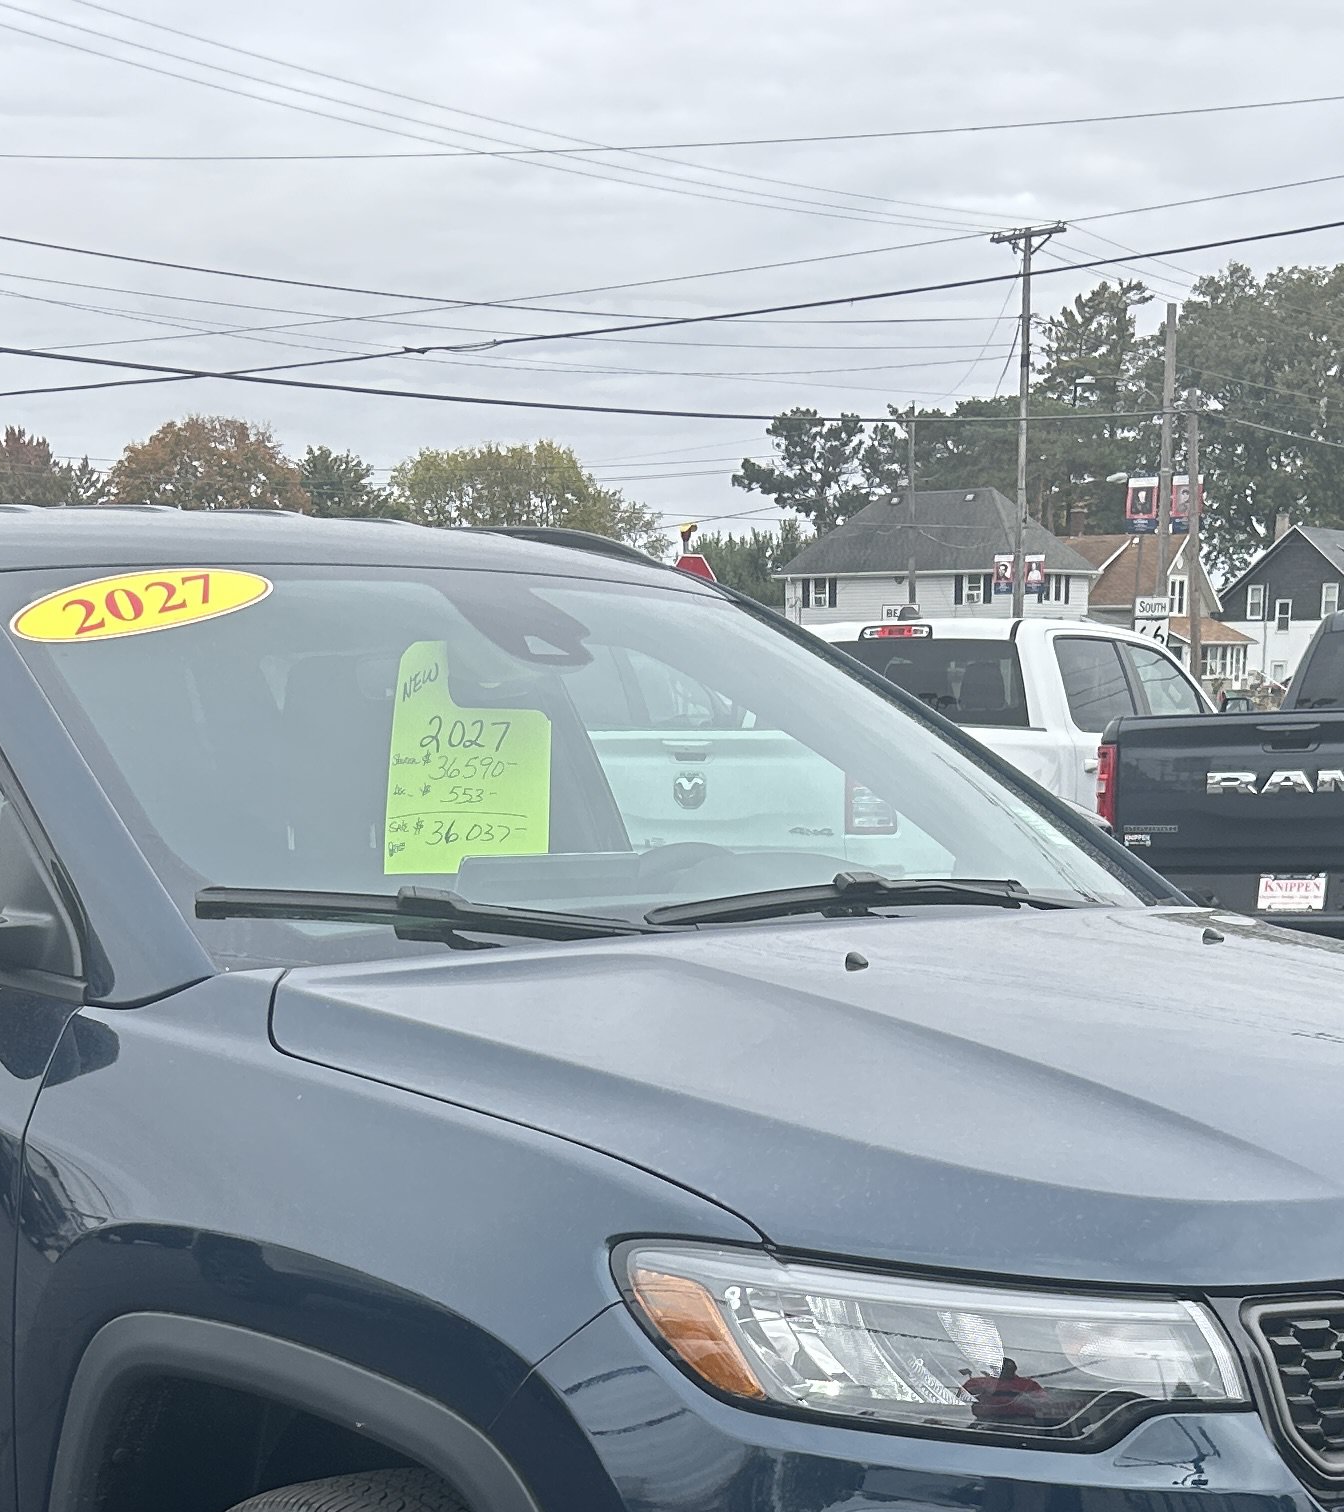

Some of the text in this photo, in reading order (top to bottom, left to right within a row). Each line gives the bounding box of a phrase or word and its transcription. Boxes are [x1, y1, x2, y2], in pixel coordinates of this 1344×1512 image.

[62, 573, 210, 635] 2027
[1139, 600, 1167, 613] SOUTH
[402, 662, 439, 702] NEW
[419, 715, 511, 753] 2027
[1264, 881, 1321, 893] KNIPPEN
